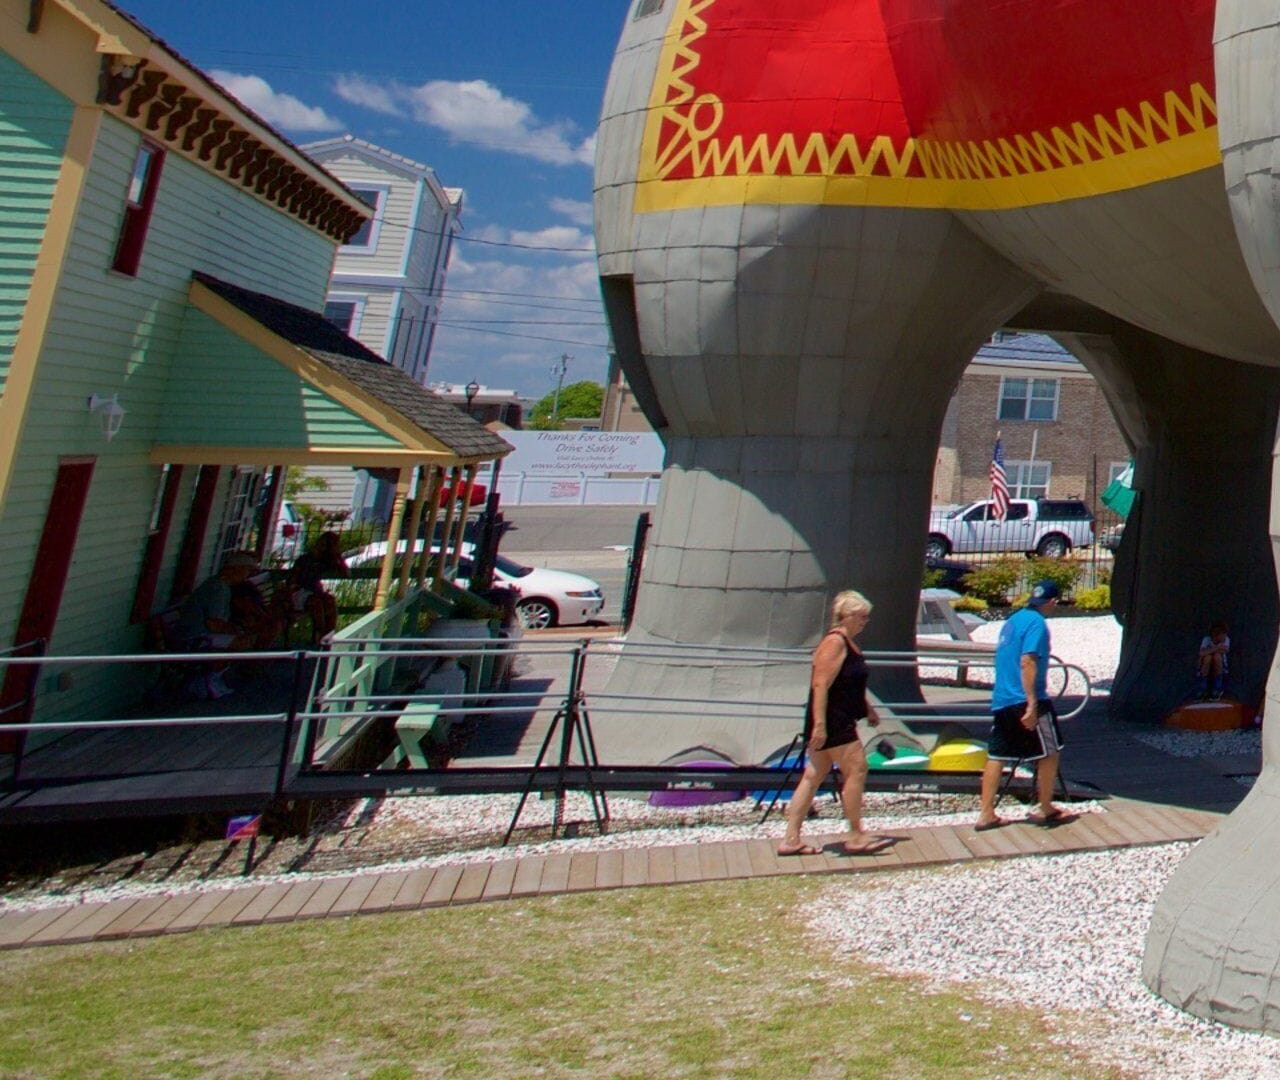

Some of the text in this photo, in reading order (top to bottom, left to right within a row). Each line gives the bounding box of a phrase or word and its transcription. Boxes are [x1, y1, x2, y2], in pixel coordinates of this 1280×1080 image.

[537, 432, 640, 445] Thanks For Coming
[555, 443, 619, 454] Drive Safely
[531, 462, 637, 471] www.lucytheelephant.org
